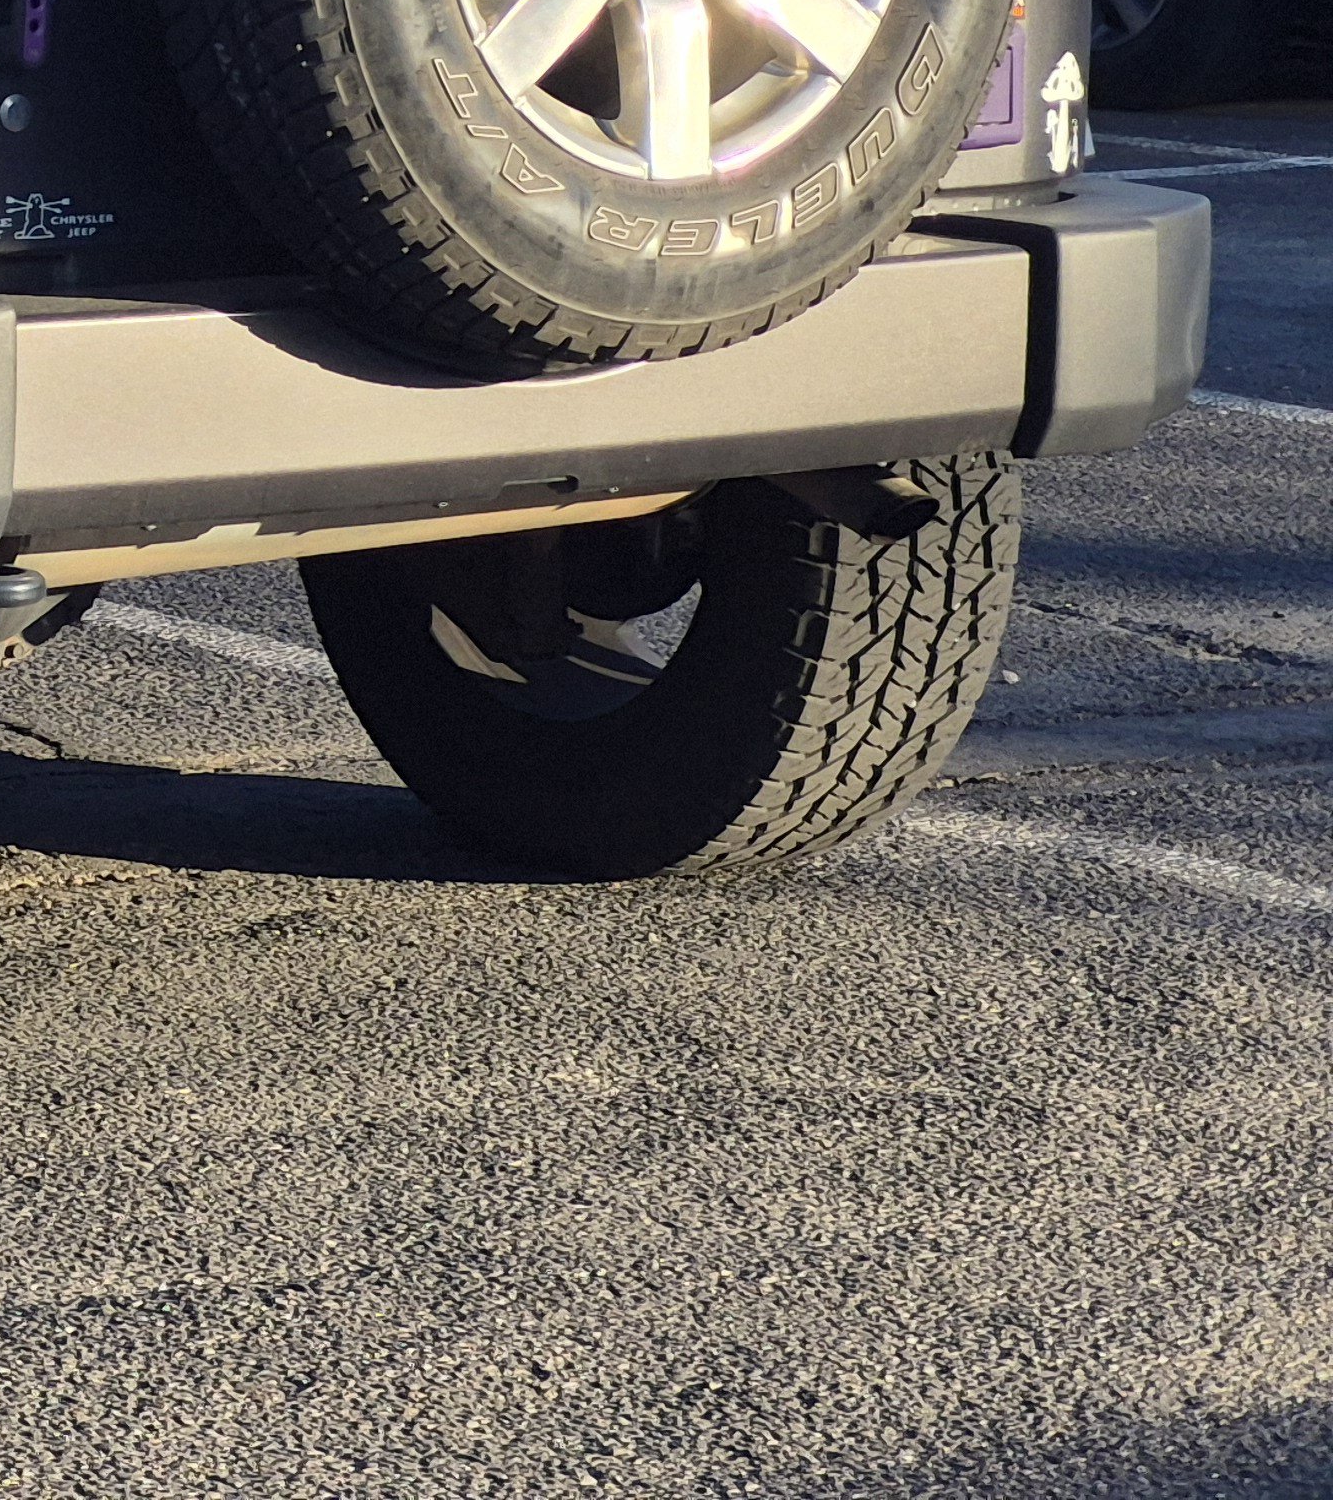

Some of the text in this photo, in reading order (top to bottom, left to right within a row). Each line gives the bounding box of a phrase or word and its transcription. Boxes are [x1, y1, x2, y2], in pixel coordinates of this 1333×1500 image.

[433, 22, 944, 257] DUELER A/T
[50, 214, 114, 225] CHRYSLER
[67, 227, 96, 239] JEEP
